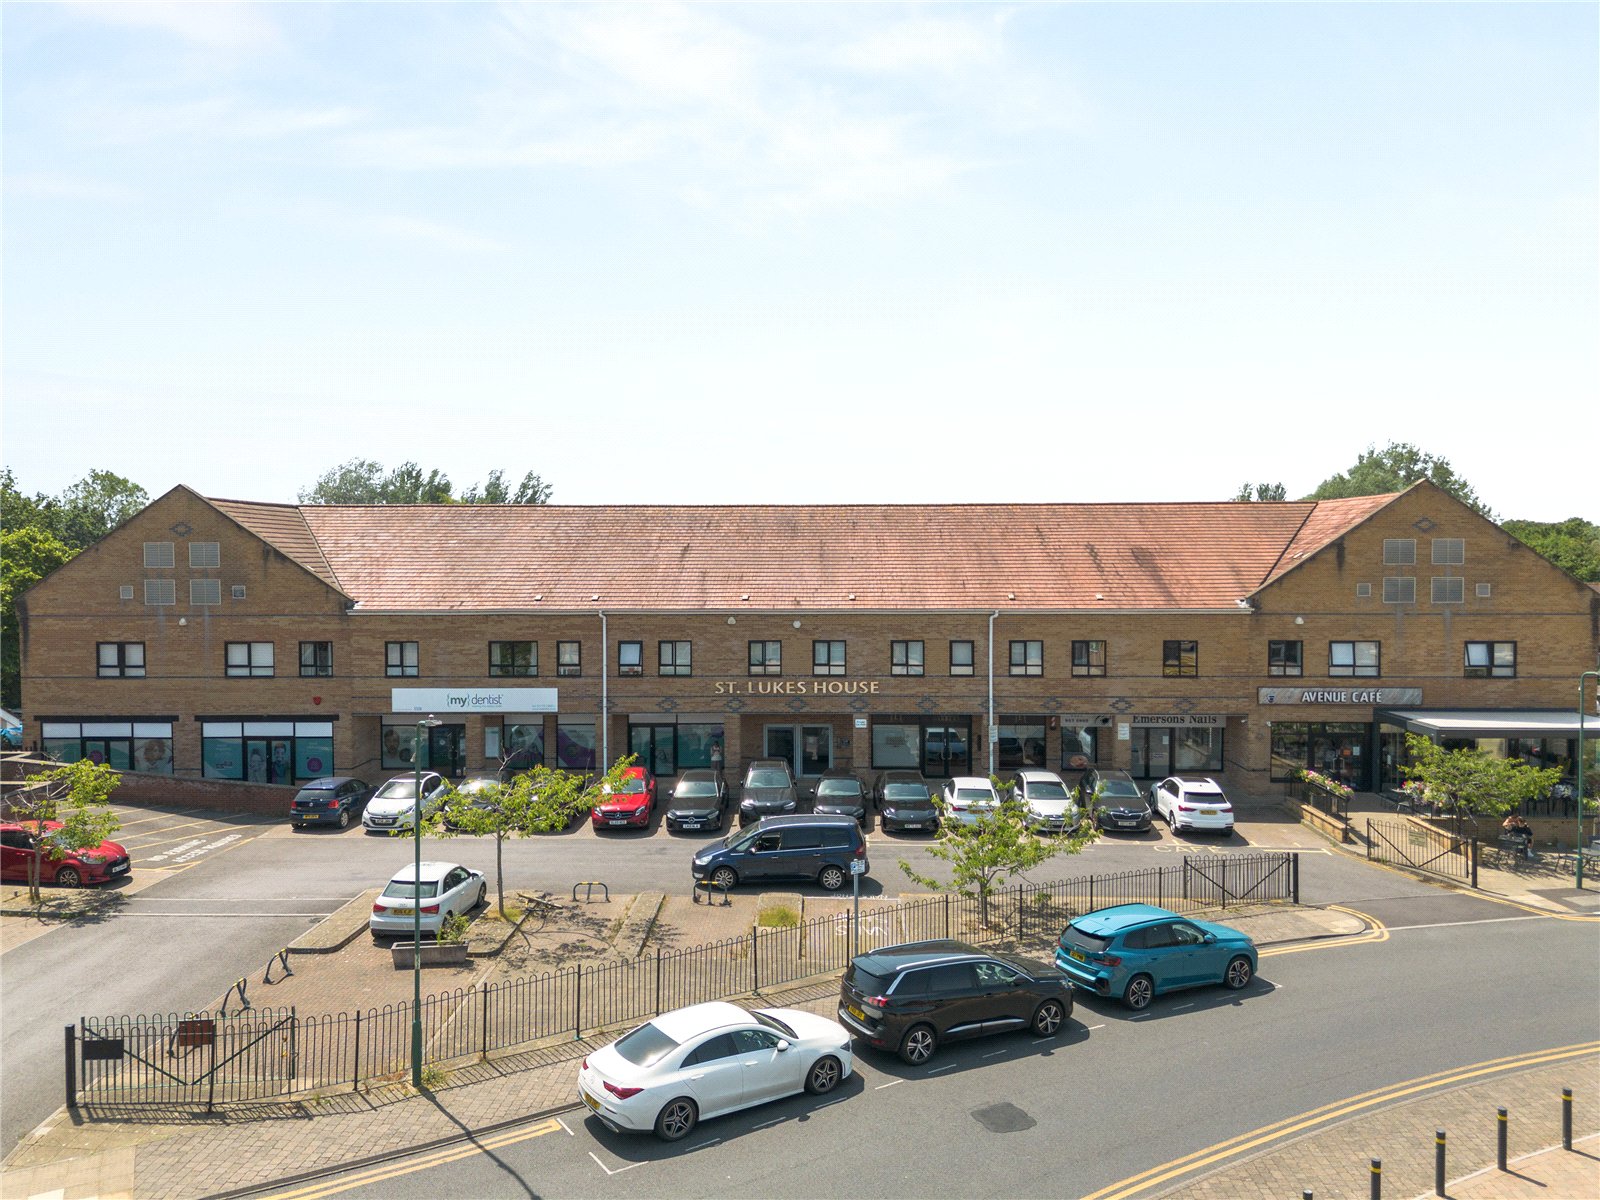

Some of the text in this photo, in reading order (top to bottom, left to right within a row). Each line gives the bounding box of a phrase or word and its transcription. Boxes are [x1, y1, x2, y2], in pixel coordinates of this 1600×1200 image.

[714, 681, 880, 694] ST. LUKES HOUSE
[471, 693, 502, 705] dentist
[1301, 689, 1382, 703] AVENUE CAFÉ
[1132, 715, 1217, 724] Emersons Nails
